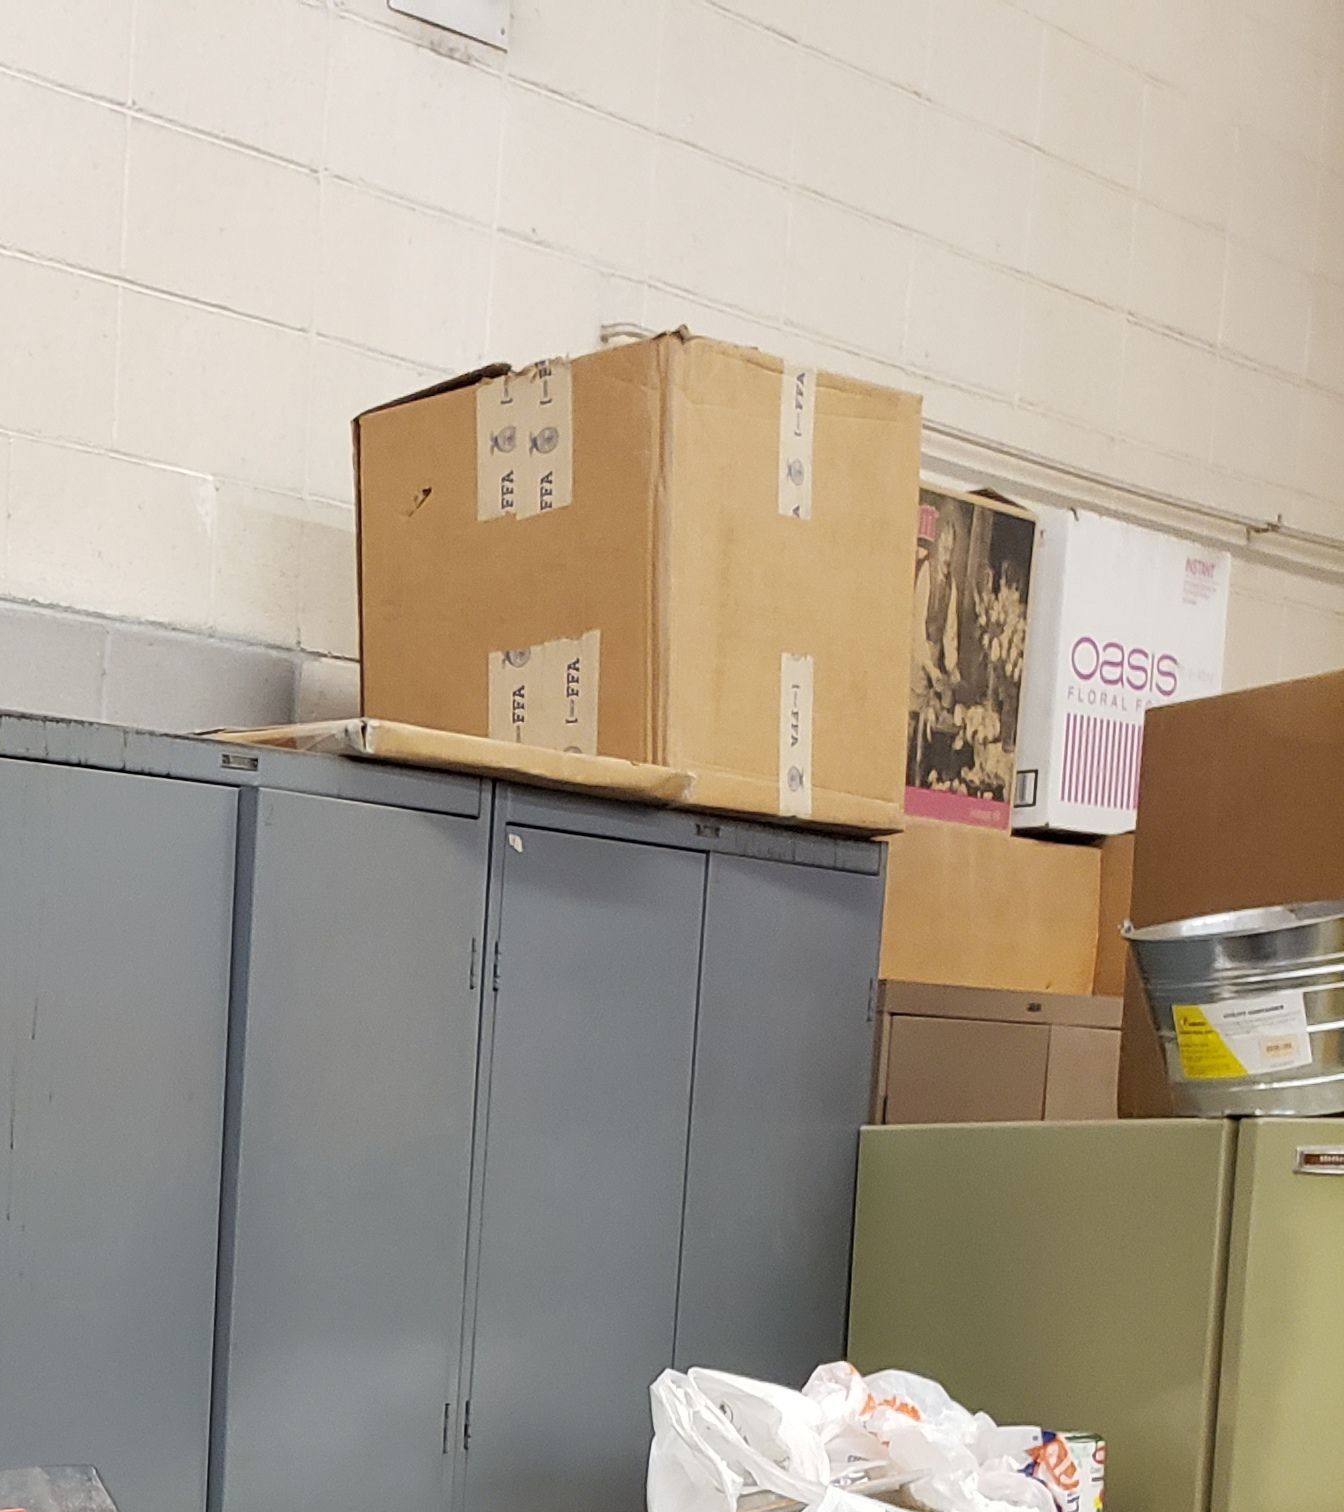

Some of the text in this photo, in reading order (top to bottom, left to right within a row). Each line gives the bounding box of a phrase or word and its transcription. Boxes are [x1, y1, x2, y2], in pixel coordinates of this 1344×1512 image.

[501, 470, 514, 510] FFA
[540, 471, 553, 511] FFA
[566, 657, 580, 698] FFA
[512, 685, 525, 724] FFA
[1067, 686, 1127, 711] FLORAL
